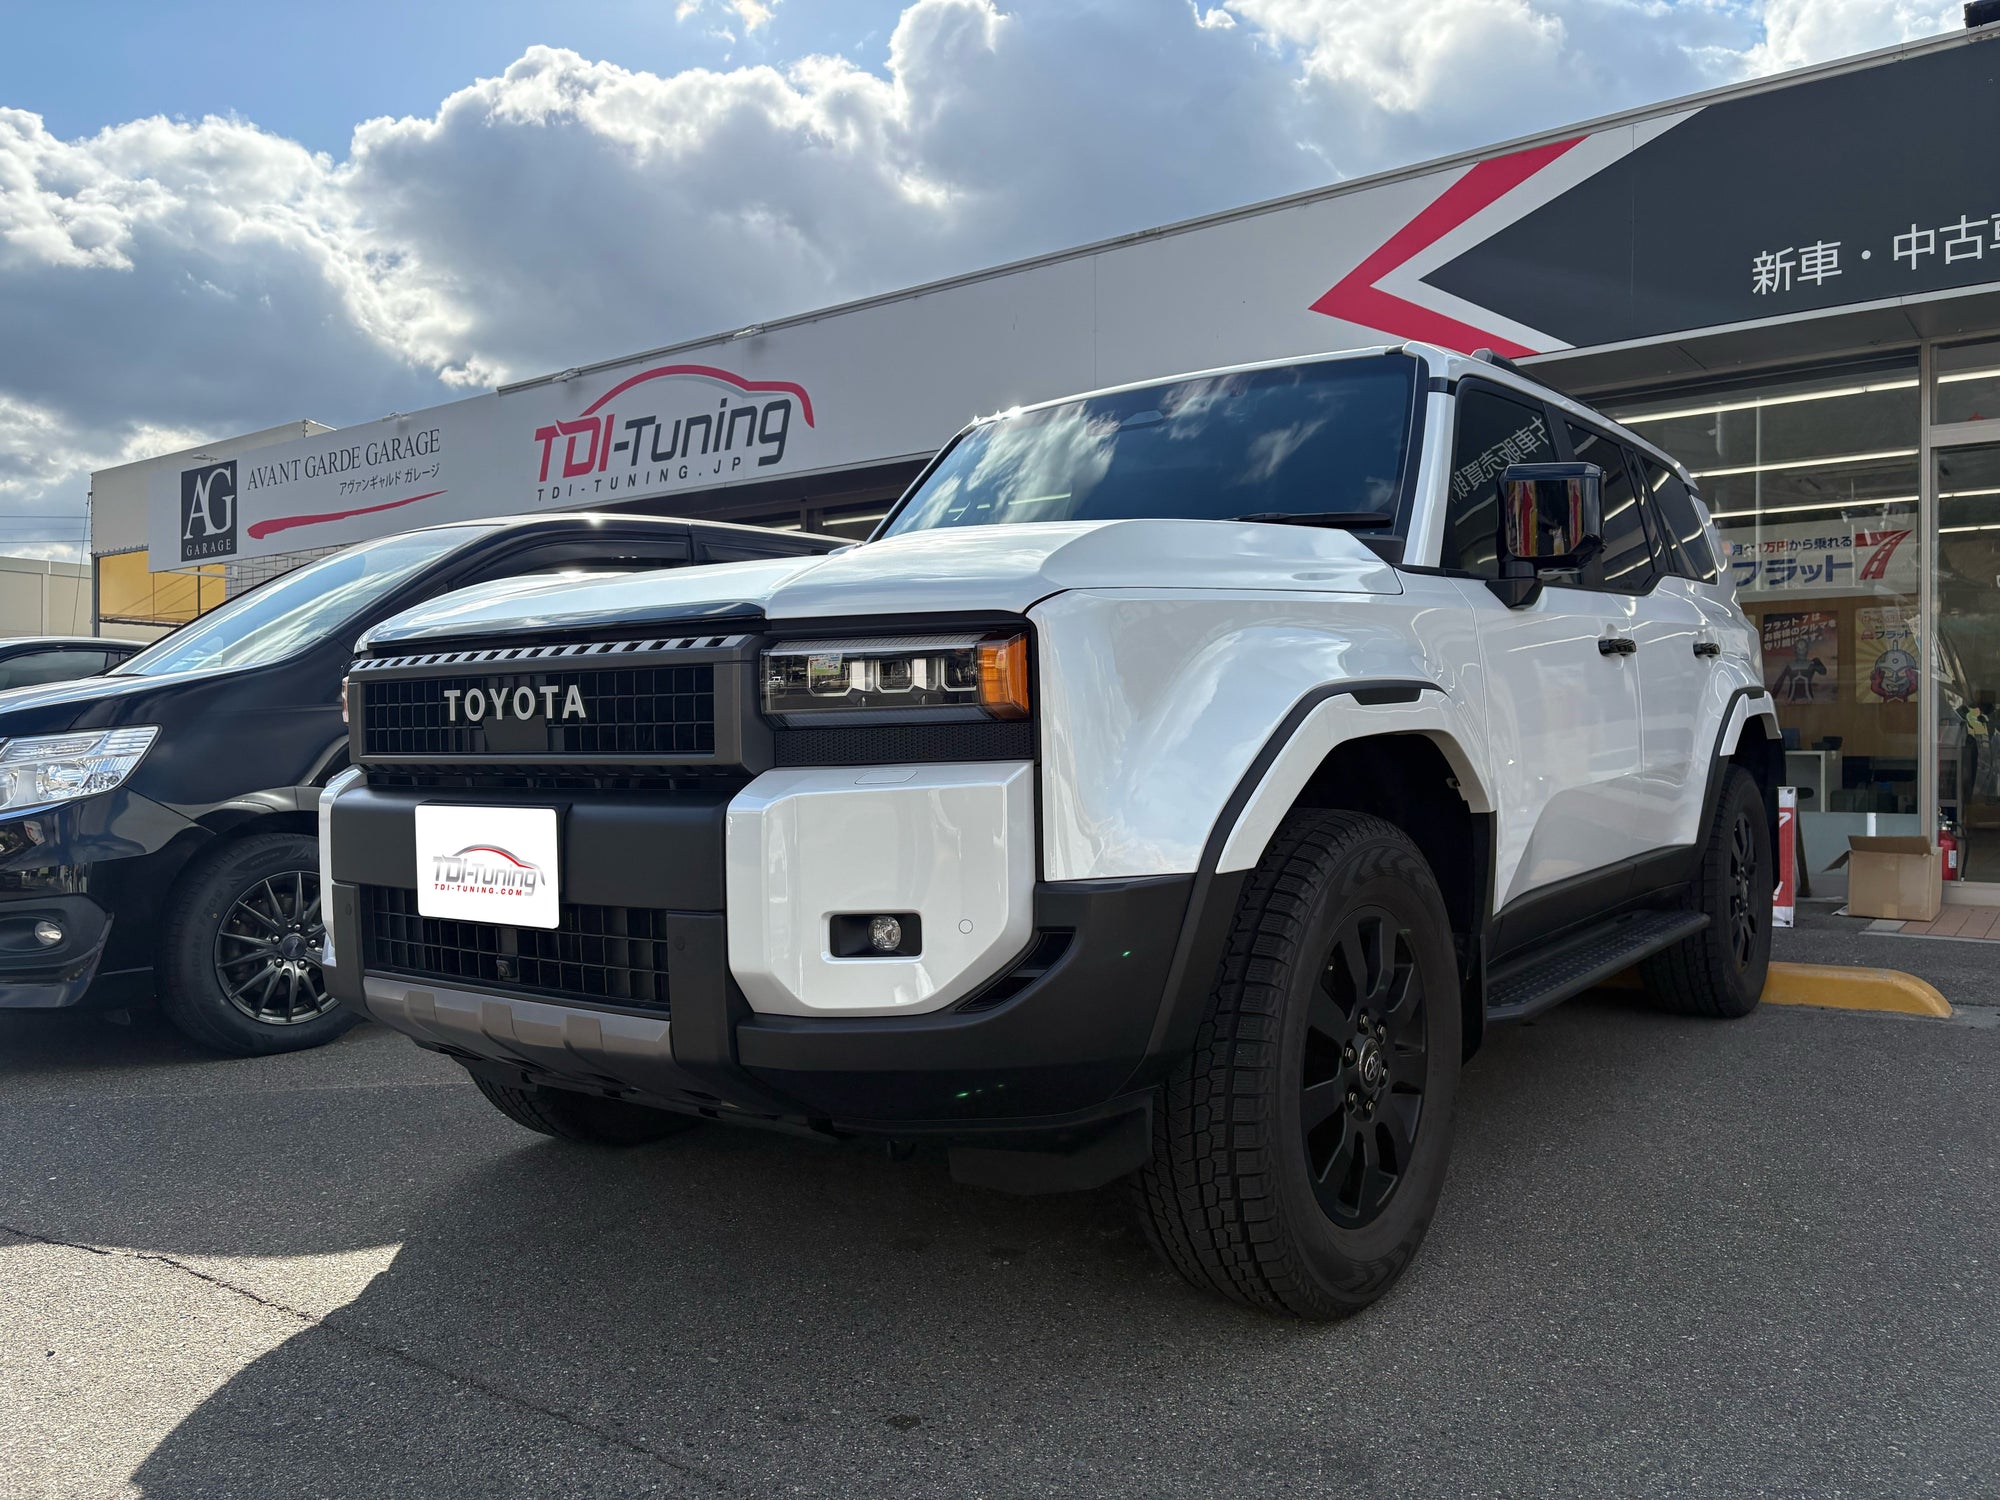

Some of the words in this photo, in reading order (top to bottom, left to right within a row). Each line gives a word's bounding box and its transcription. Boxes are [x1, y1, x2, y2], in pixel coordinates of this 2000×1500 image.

[1752, 212, 2000, 296] 新車・中古
[247, 459, 302, 490] AVANT
[304, 445, 362, 479] GARDE
[365, 427, 441, 467] GARAGE
[534, 397, 793, 482] TDI-Tuning
[340, 470, 402, 496] アヴァンギャルド
[404, 461, 440, 484] ガレージ
[537, 456, 742, 502] TDI-TUNING.JP
[183, 466, 235, 540] AG
[186, 538, 232, 557] GARAGE
[443, 684, 587, 722] TOYOTA
[432, 854, 538, 897] TDI-Tuning
[434, 883, 522, 896] TDI-TUNING.COM
